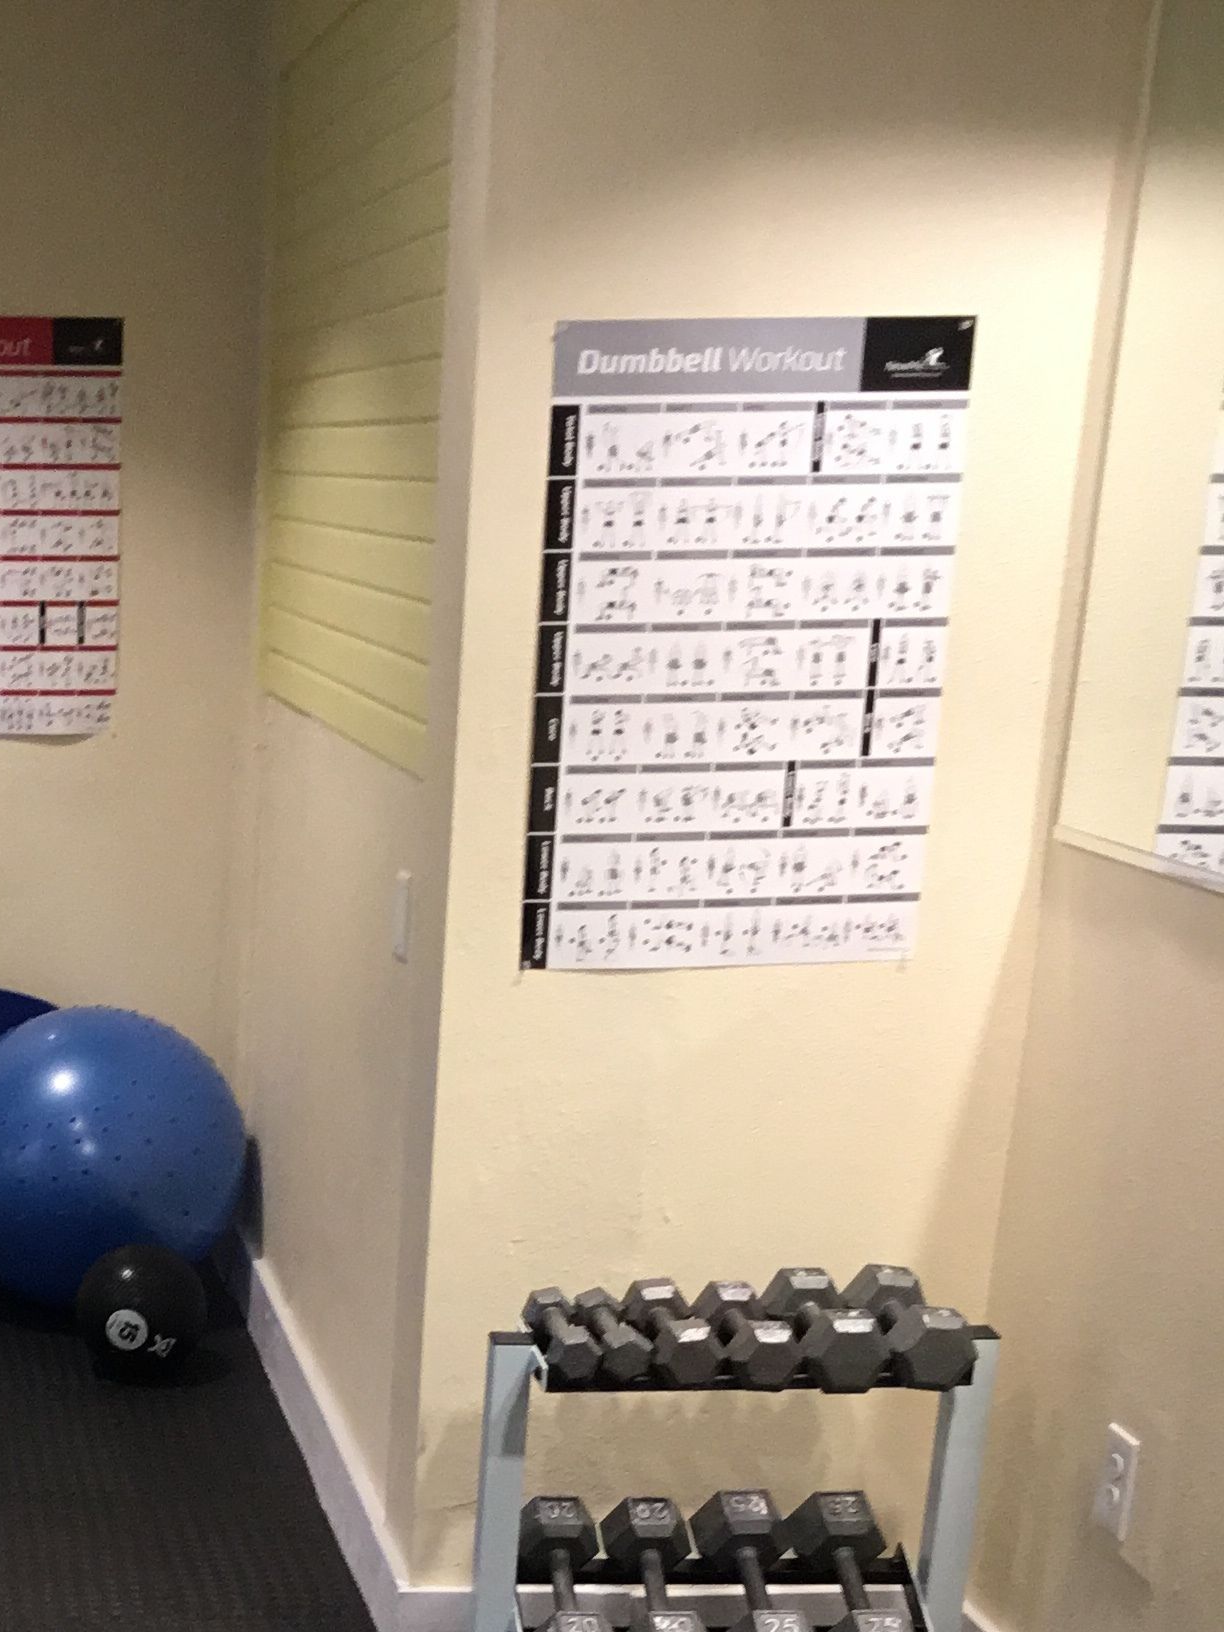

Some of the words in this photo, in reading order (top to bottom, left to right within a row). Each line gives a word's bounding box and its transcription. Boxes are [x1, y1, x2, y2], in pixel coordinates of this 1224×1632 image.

[576, 347, 724, 375] Dumbbell
[727, 347, 847, 374] Workout
[117, 1320, 141, 1344] 15
